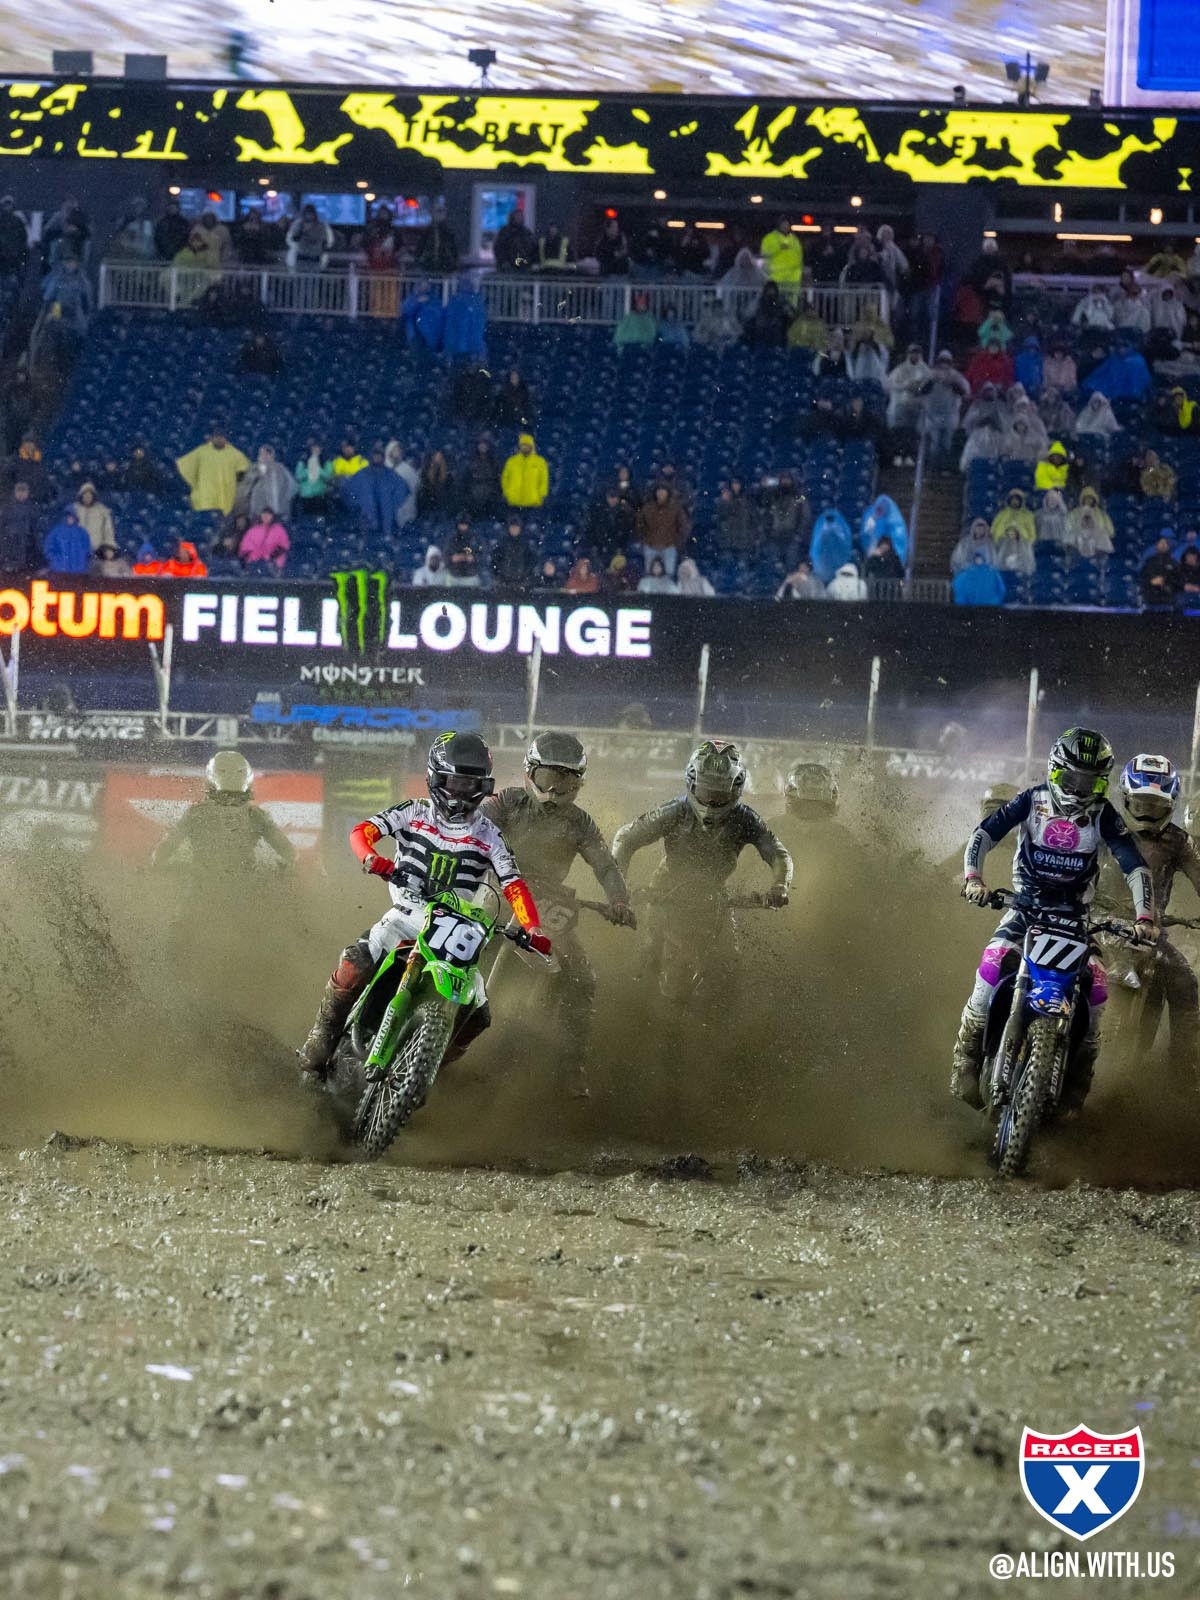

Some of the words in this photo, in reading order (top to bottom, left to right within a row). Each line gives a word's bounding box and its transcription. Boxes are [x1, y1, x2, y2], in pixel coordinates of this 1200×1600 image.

[388, 600, 652, 657] LOUNGE
[1045, 854, 1084, 868] YAMAHA
[429, 916, 484, 961] 18
[1029, 934, 1088, 970] 177
